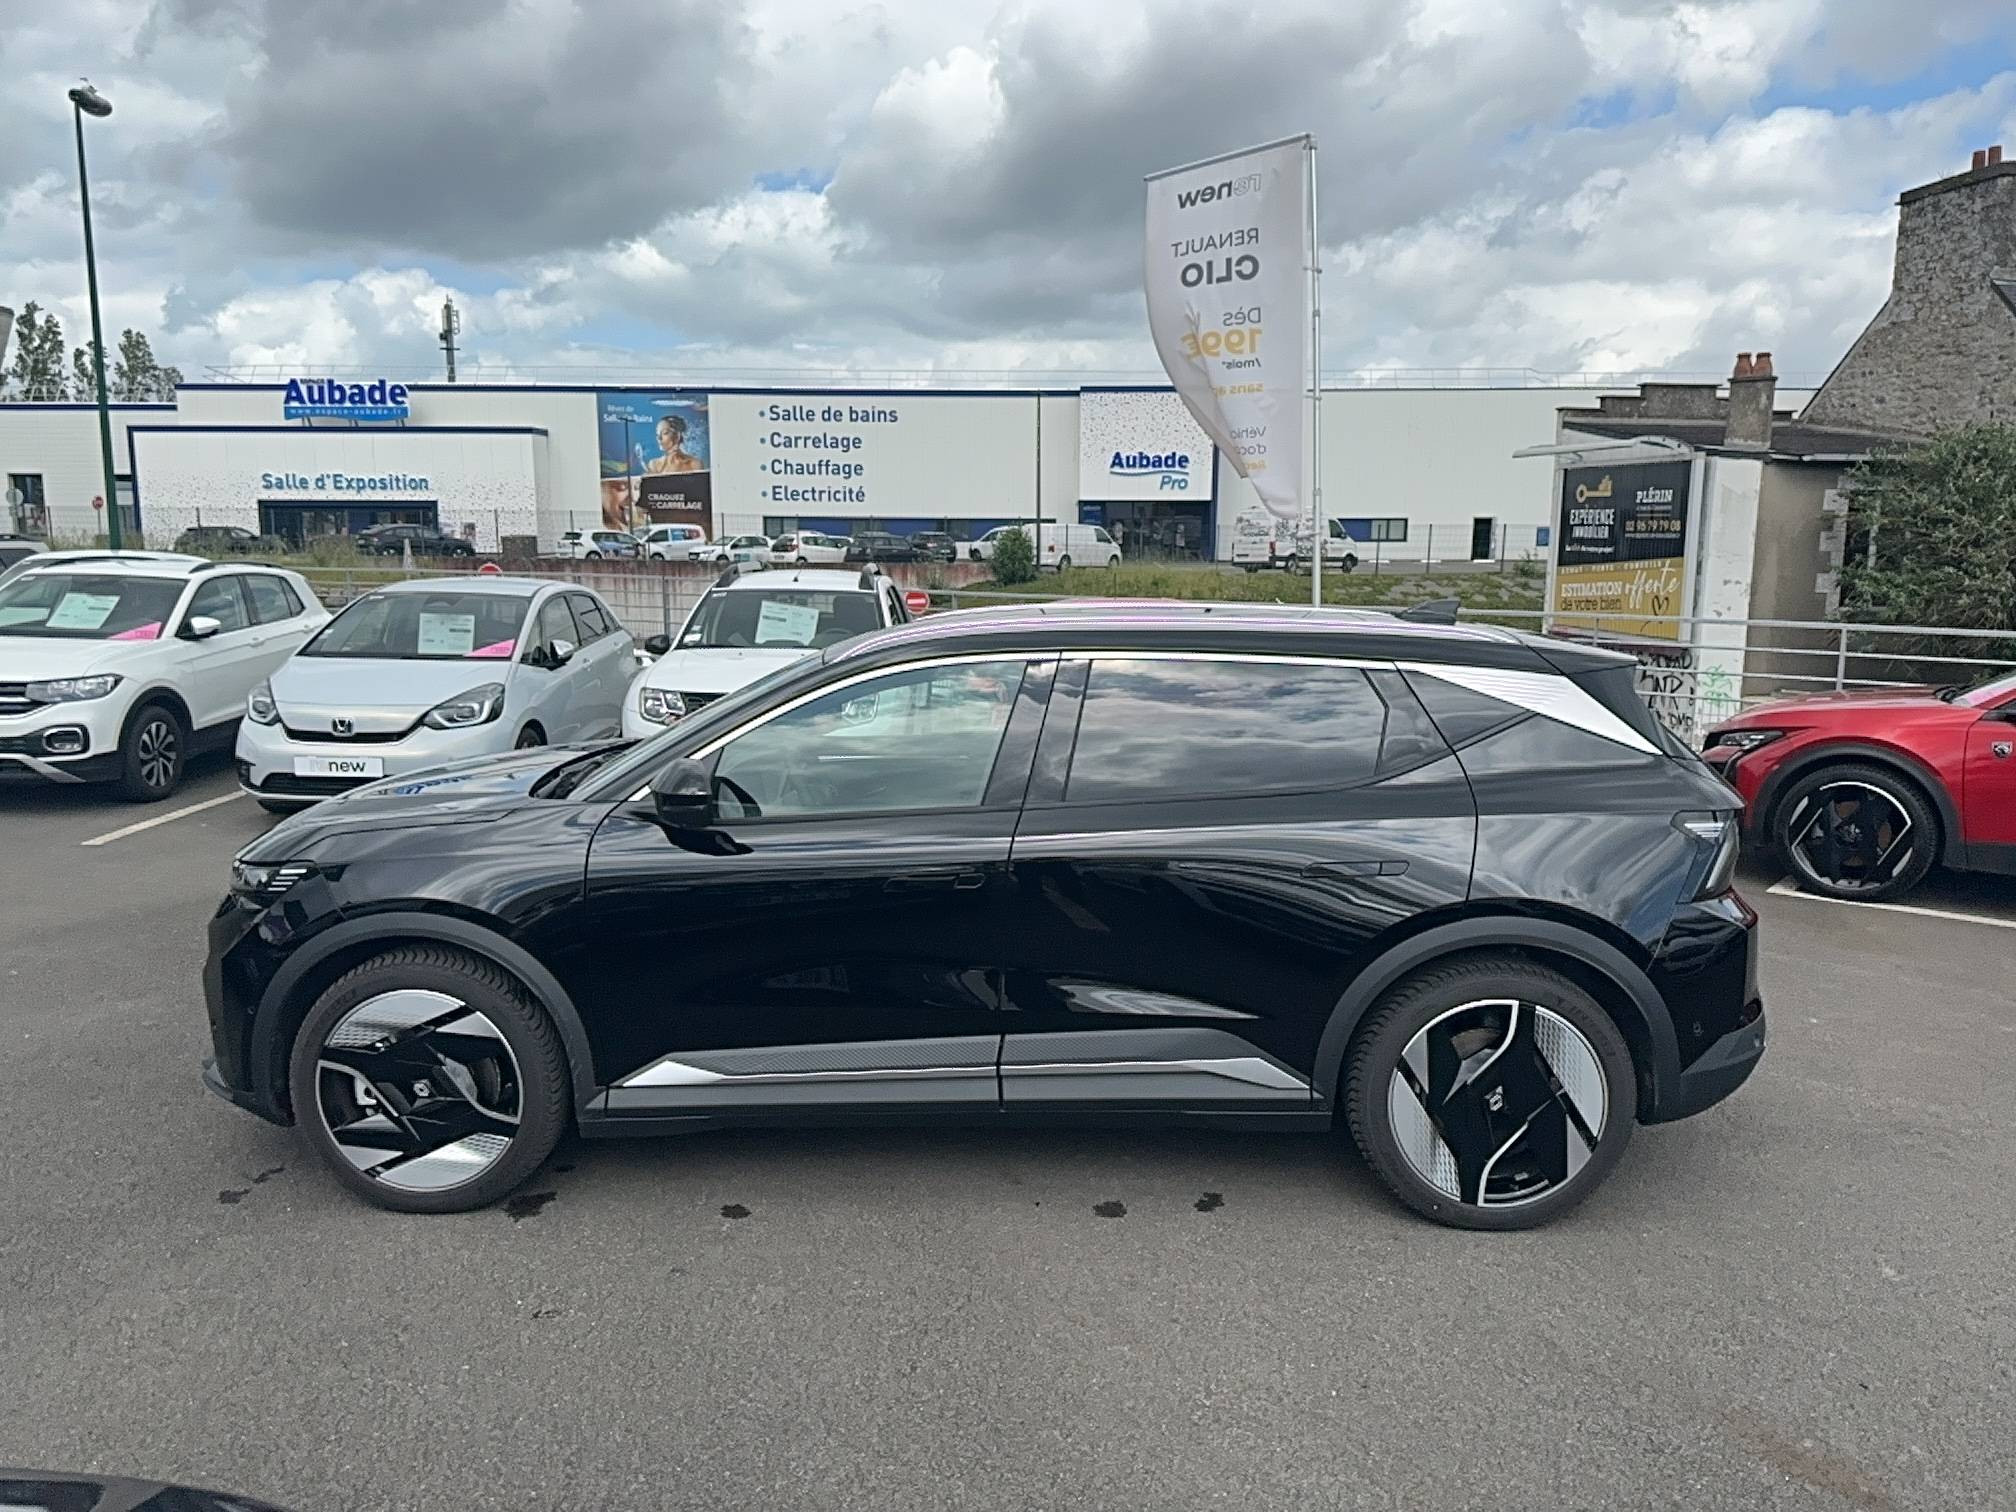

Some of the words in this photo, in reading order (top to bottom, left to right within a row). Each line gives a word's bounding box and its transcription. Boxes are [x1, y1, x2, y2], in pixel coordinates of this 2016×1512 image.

[284, 378, 407, 405] Aubade
[769, 405, 815, 421] Salle
[821, 406, 843, 422] de
[849, 406, 899, 423] bains
[770, 432, 863, 453] Carrelage
[1110, 451, 1189, 469] Aubade
[771, 459, 864, 480] Chauffage
[262, 473, 309, 490] Salle
[315, 473, 429, 494] d'Exposition
[1159, 475, 1188, 490] Pro
[772, 485, 866, 502] Electricité
[1560, 581, 1623, 597] ESTIMATION
